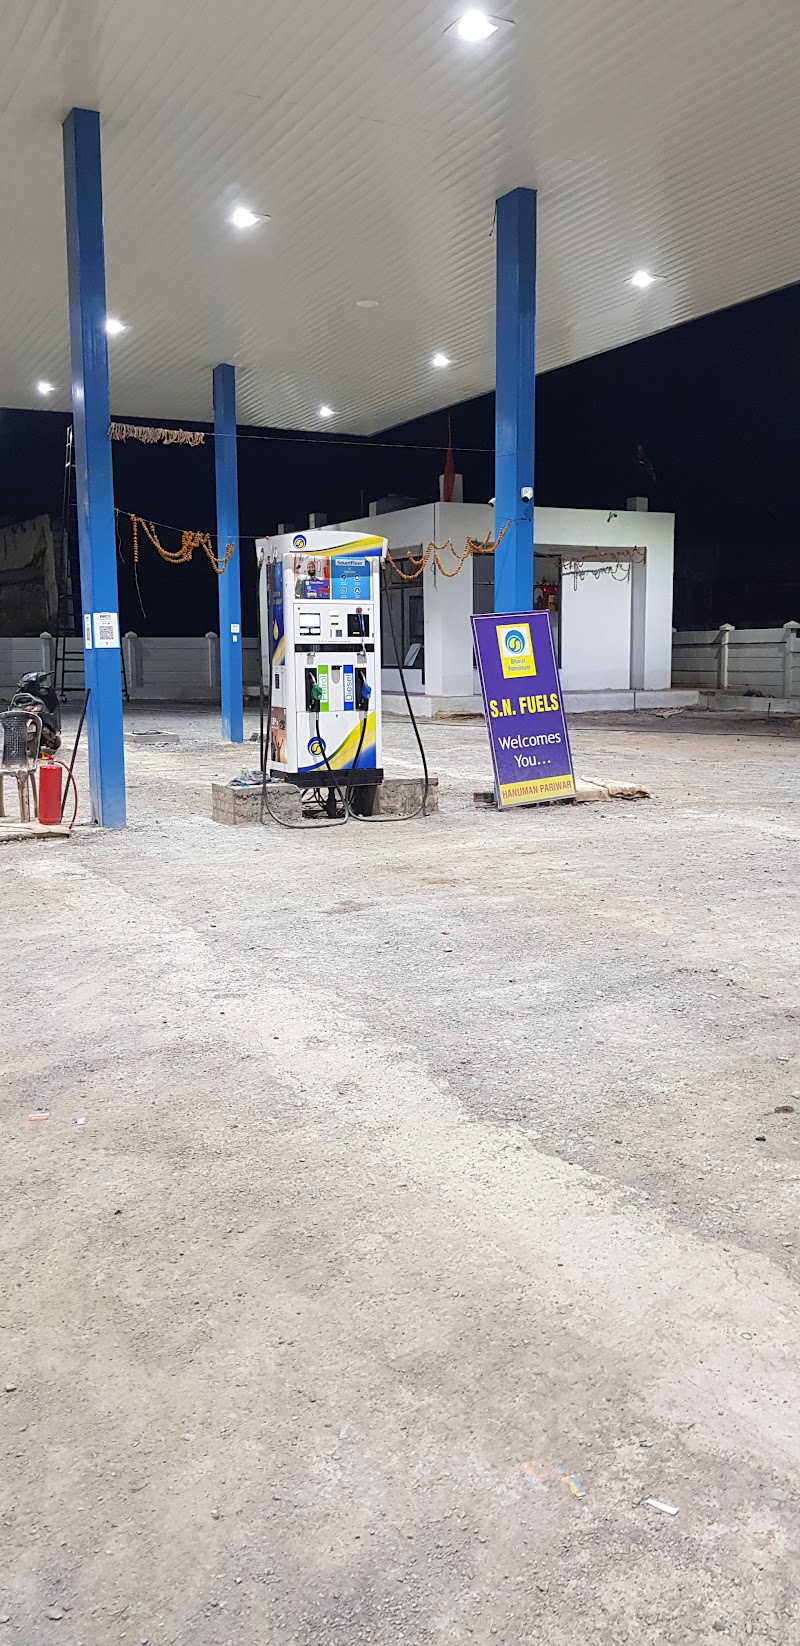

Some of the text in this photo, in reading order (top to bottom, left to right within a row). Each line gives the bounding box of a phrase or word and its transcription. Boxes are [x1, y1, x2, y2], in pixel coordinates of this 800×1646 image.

[345, 674, 353, 701] Diesel
[489, 693, 559, 718] S.N. FUELS
[498, 733, 562, 750] Welcomes
[514, 754, 551, 768] You...
[502, 780, 572, 799] HANUMAN PARIWAR
